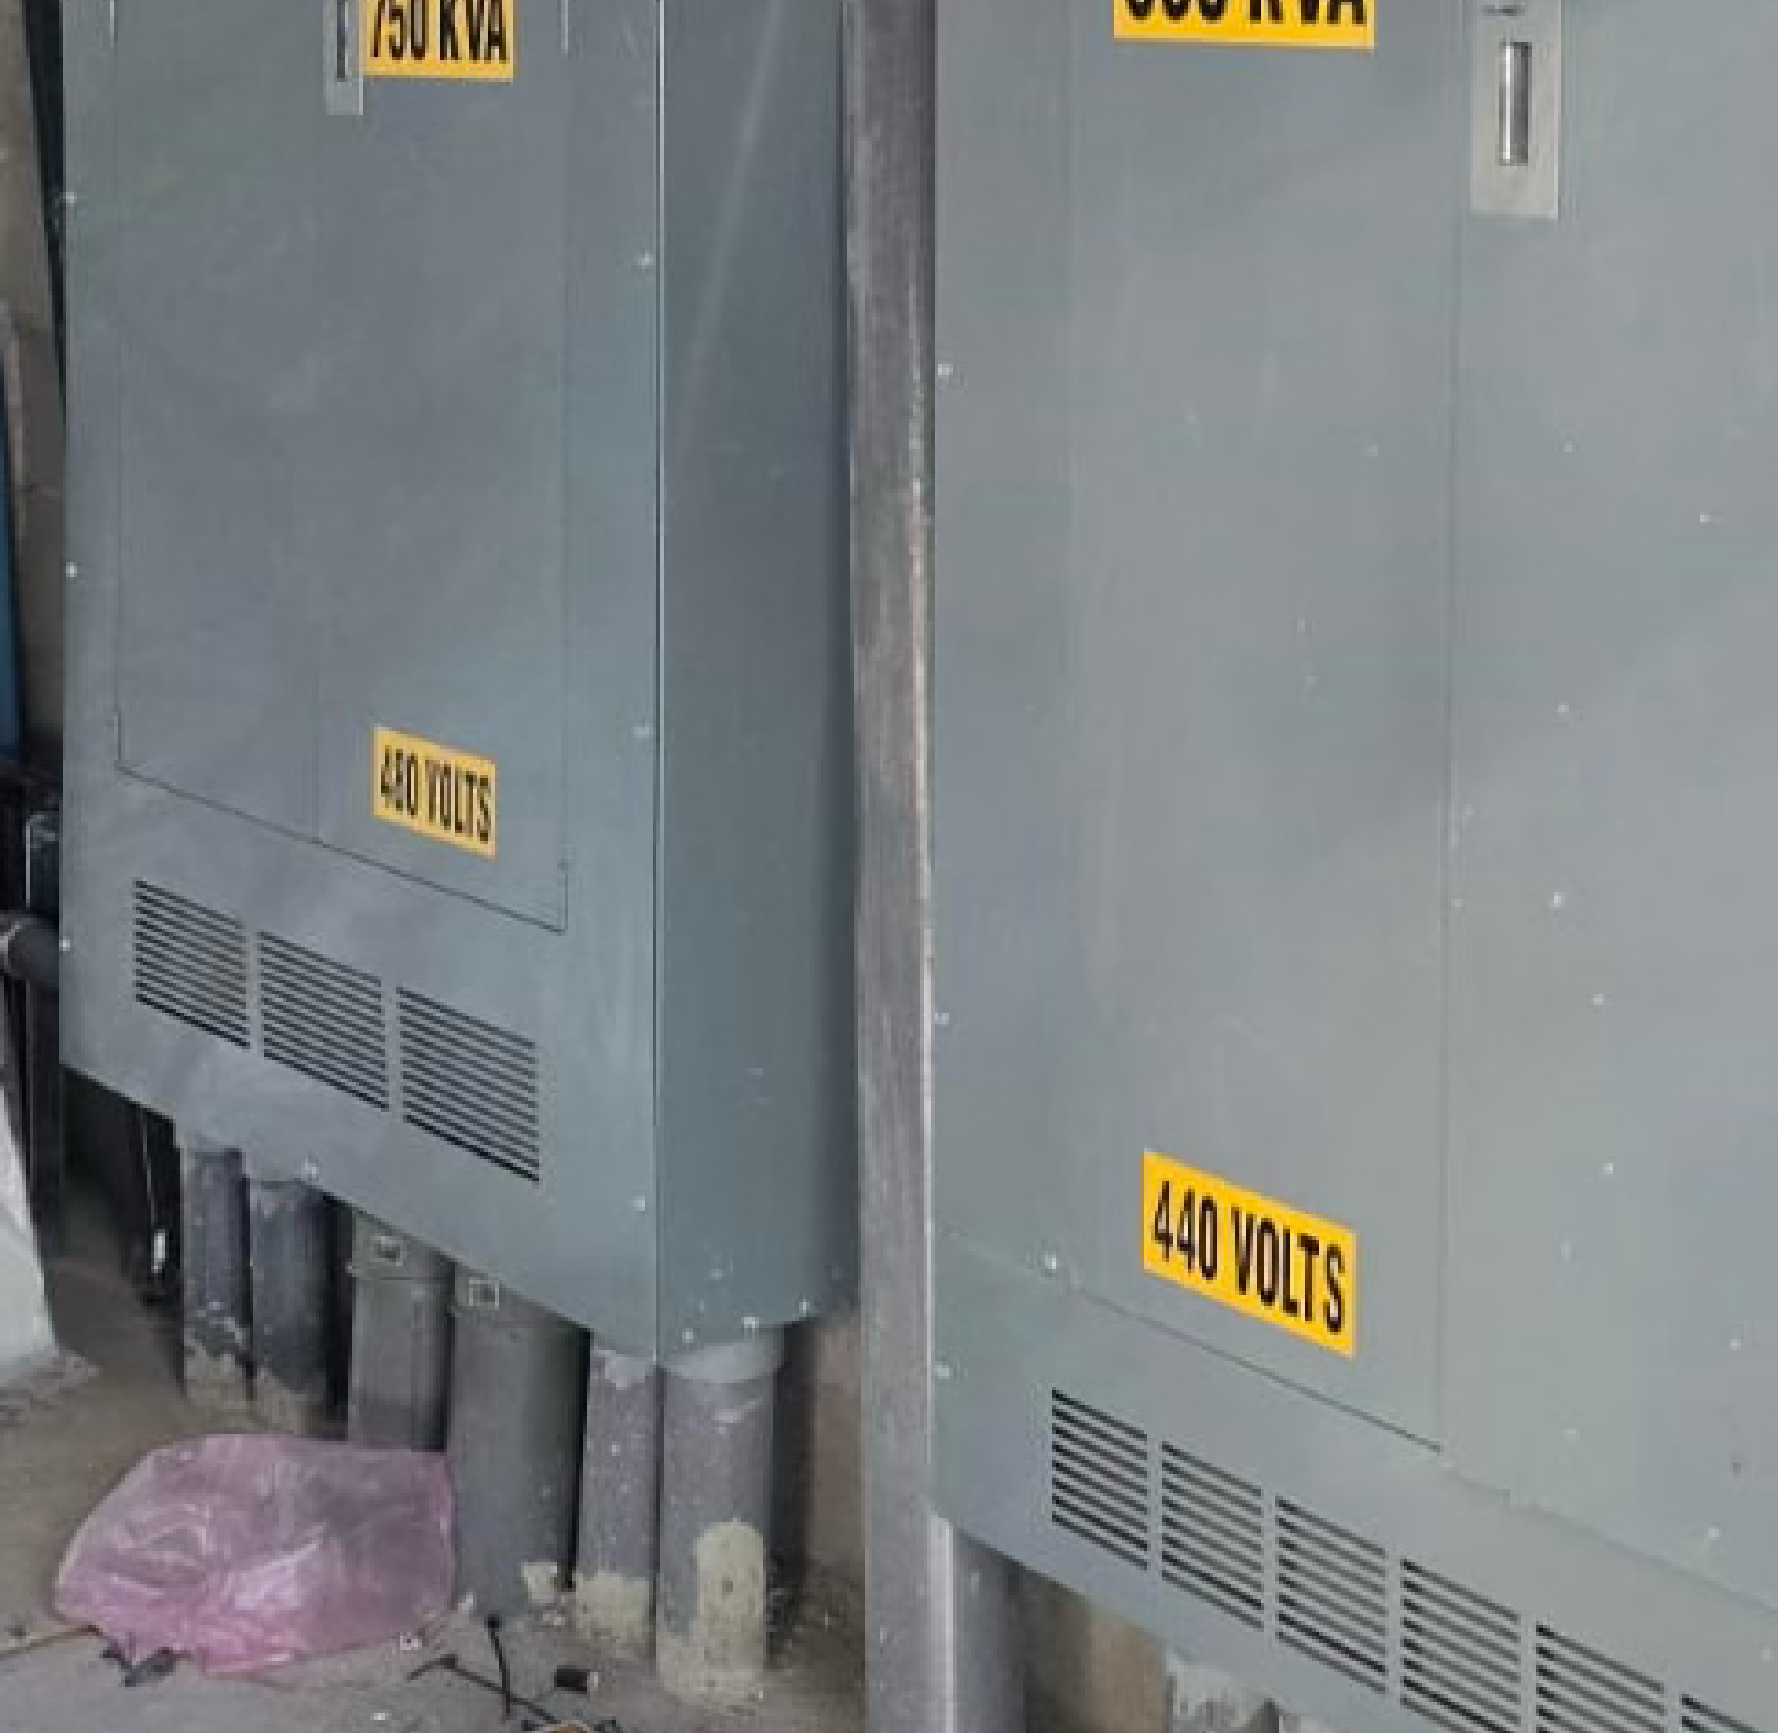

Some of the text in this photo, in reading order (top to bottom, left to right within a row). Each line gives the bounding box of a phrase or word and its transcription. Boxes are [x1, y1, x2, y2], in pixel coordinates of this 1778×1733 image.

[380, 744, 491, 845] 480 VOLTS
[1154, 1180, 1345, 1336] 440 VOLTS
